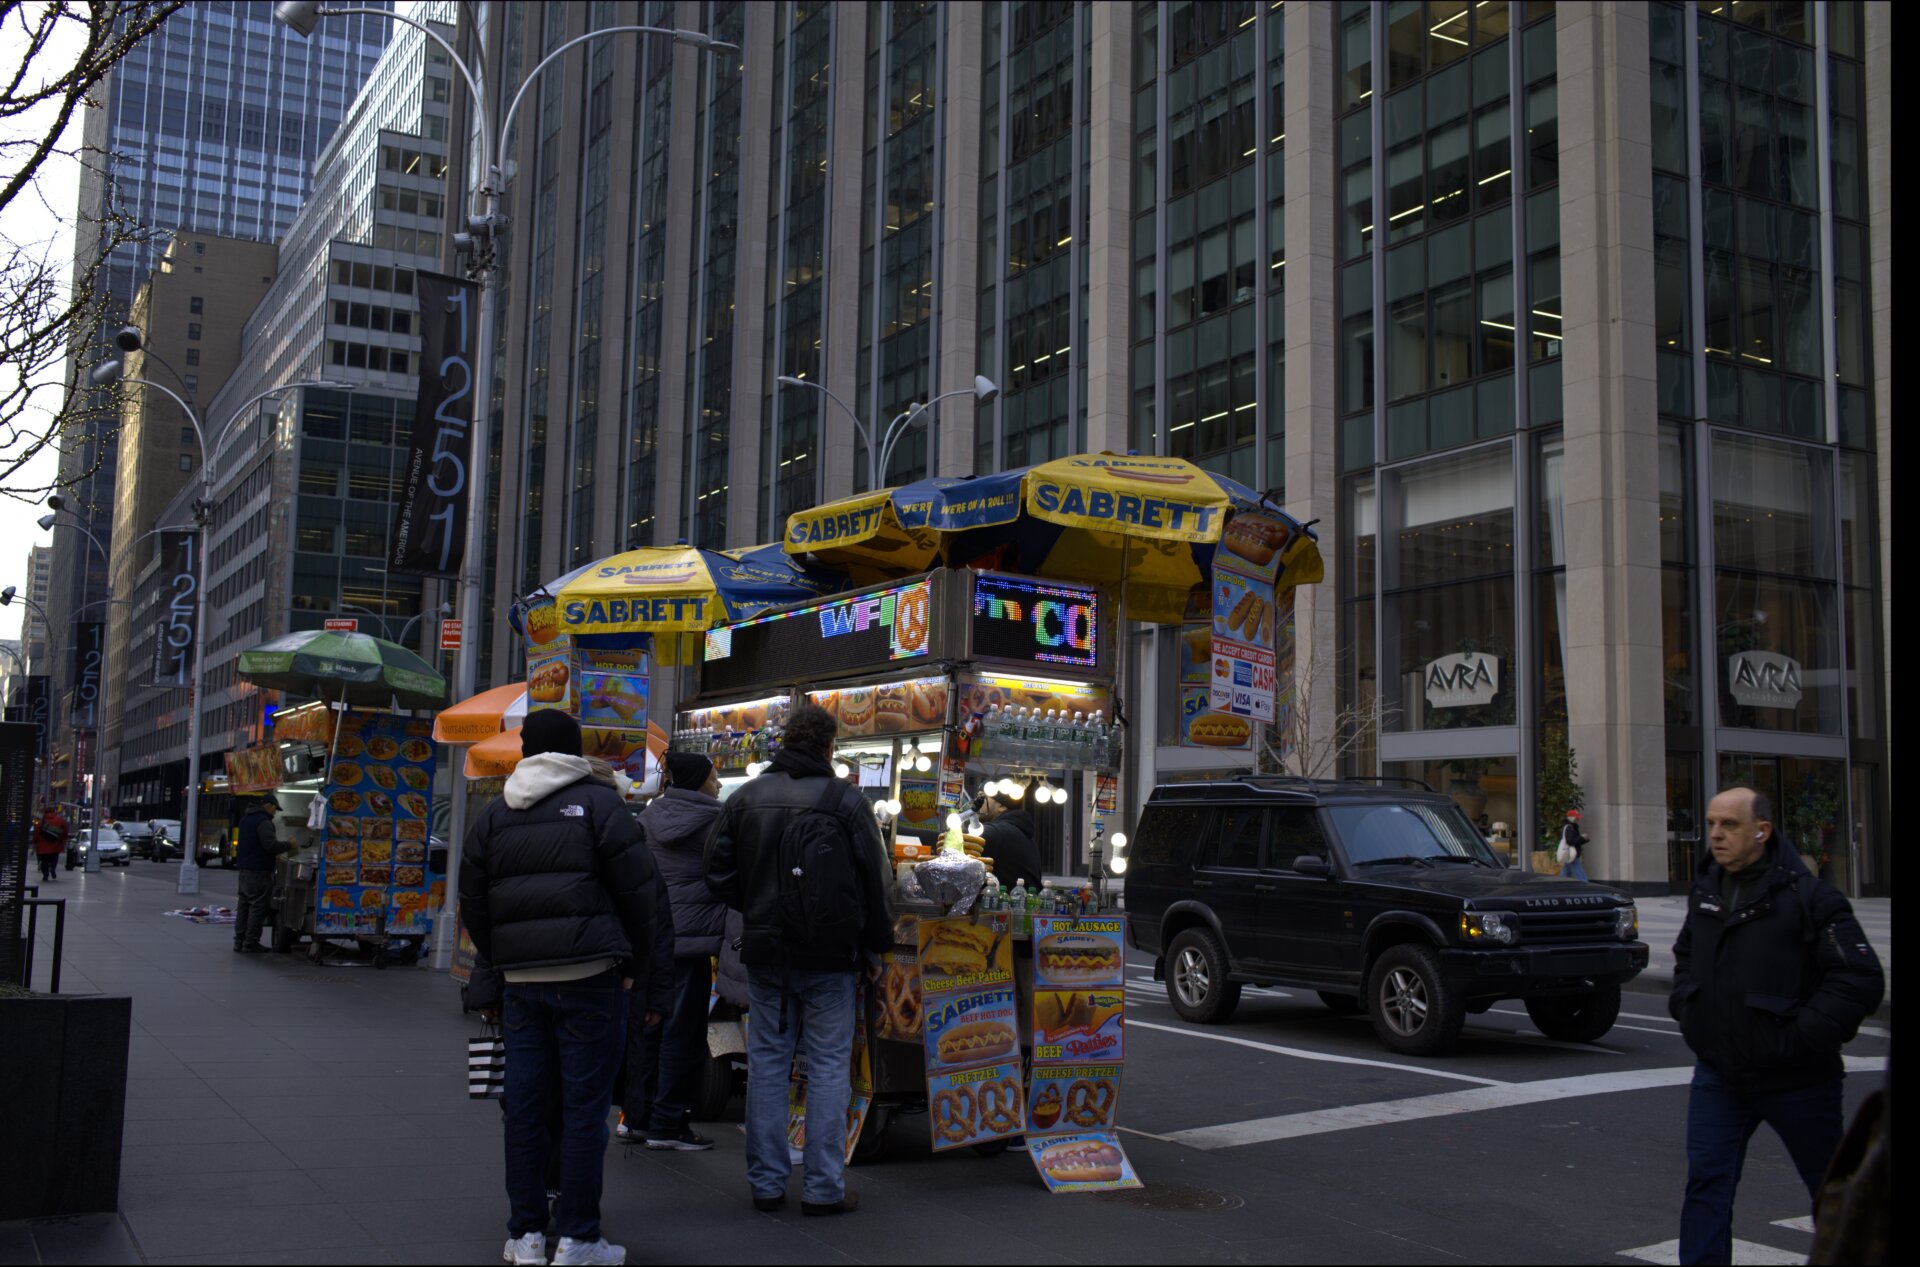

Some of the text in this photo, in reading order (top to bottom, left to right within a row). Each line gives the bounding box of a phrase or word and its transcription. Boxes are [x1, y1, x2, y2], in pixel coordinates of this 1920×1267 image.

[426, 287, 471, 571] 1251
[1071, 459, 1187, 470] SABRETT
[394, 448, 423, 565] AVENUE OF THE AMERICAS
[940, 502, 967, 515] WE'RE
[967, 500, 978, 512] ON
[979, 498, 986, 509] A
[988, 494, 1005, 508] ROLL
[1035, 481, 1219, 533] SABRETT
[597, 561, 696, 578] SABRETT
[168, 535, 196, 685] 1251
[563, 597, 710, 625] SABRETT
[1213, 641, 1273, 665] WE ACCEPT CREDIT CARDS
[81, 624, 101, 726] 1251
[596, 662, 635, 672] HOT DOG
[1426, 657, 1493, 690] AVRA
[1735, 656, 1802, 693] AVRA
[1252, 665, 1274, 692] CASH
[1235, 692, 1251, 706] VISA
[1526, 897, 1604, 907] LAND ROVER
[1052, 921, 1071, 931] HOT
[923, 969, 1010, 991] Cheese Beef Patties
[926, 990, 1015, 1032] SABRETT
[960, 1008, 1014, 1023] BEEF HOT DOG
[1036, 1045, 1063, 1058] BEEF
[1066, 1033, 1117, 1056] Patties
[950, 1068, 1000, 1086] PRETZEL
[1036, 1067, 1118, 1079] CHEESE PRETZEL
